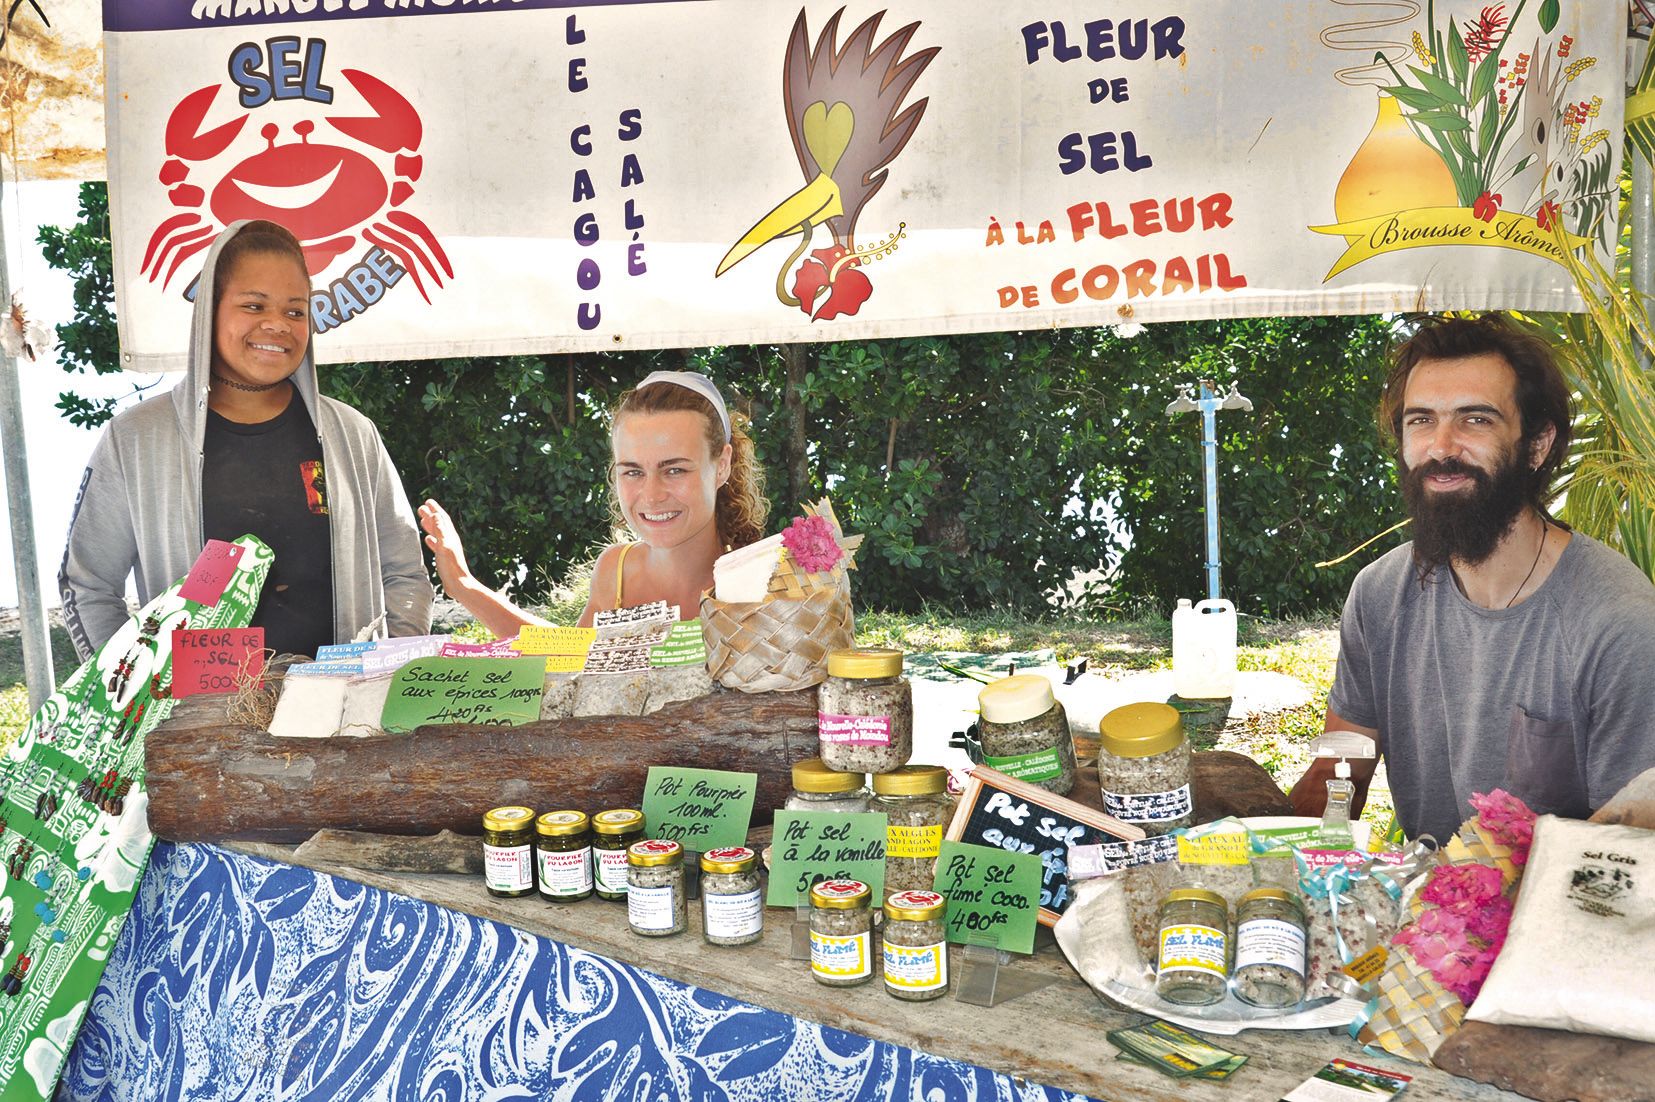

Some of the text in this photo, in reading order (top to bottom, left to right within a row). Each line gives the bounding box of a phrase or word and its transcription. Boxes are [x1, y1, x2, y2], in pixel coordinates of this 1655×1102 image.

[1021, 16, 1186, 65] FLEUR
[228, 36, 334, 109] SEL
[1087, 77, 1130, 104] DE
[1058, 131, 1153, 175] SEL
[618, 108, 647, 277] SALÉ
[570, 124, 601, 331] CAGOU
[985, 192, 1234, 247] À LA FLEUR
[1370, 212, 1473, 250] Brousse
[309, 245, 408, 334] RABE
[997, 252, 1248, 309] DE CORAIL
[180, 632, 259, 648] FLEUR DE
[200, 674, 232, 690] 500
[402, 667, 513, 684] Sachet sel
[401, 686, 435, 698] aux
[445, 684, 498, 705] épices
[655, 777, 684, 796] Pot
[984, 792, 1030, 825] Pot
[784, 820, 852, 842] Pot sel
[807, 845, 829, 861] la
[1582, 851, 1637, 865] Sel Gris
[946, 854, 976, 879] Pot
[984, 863, 1016, 884] sel
